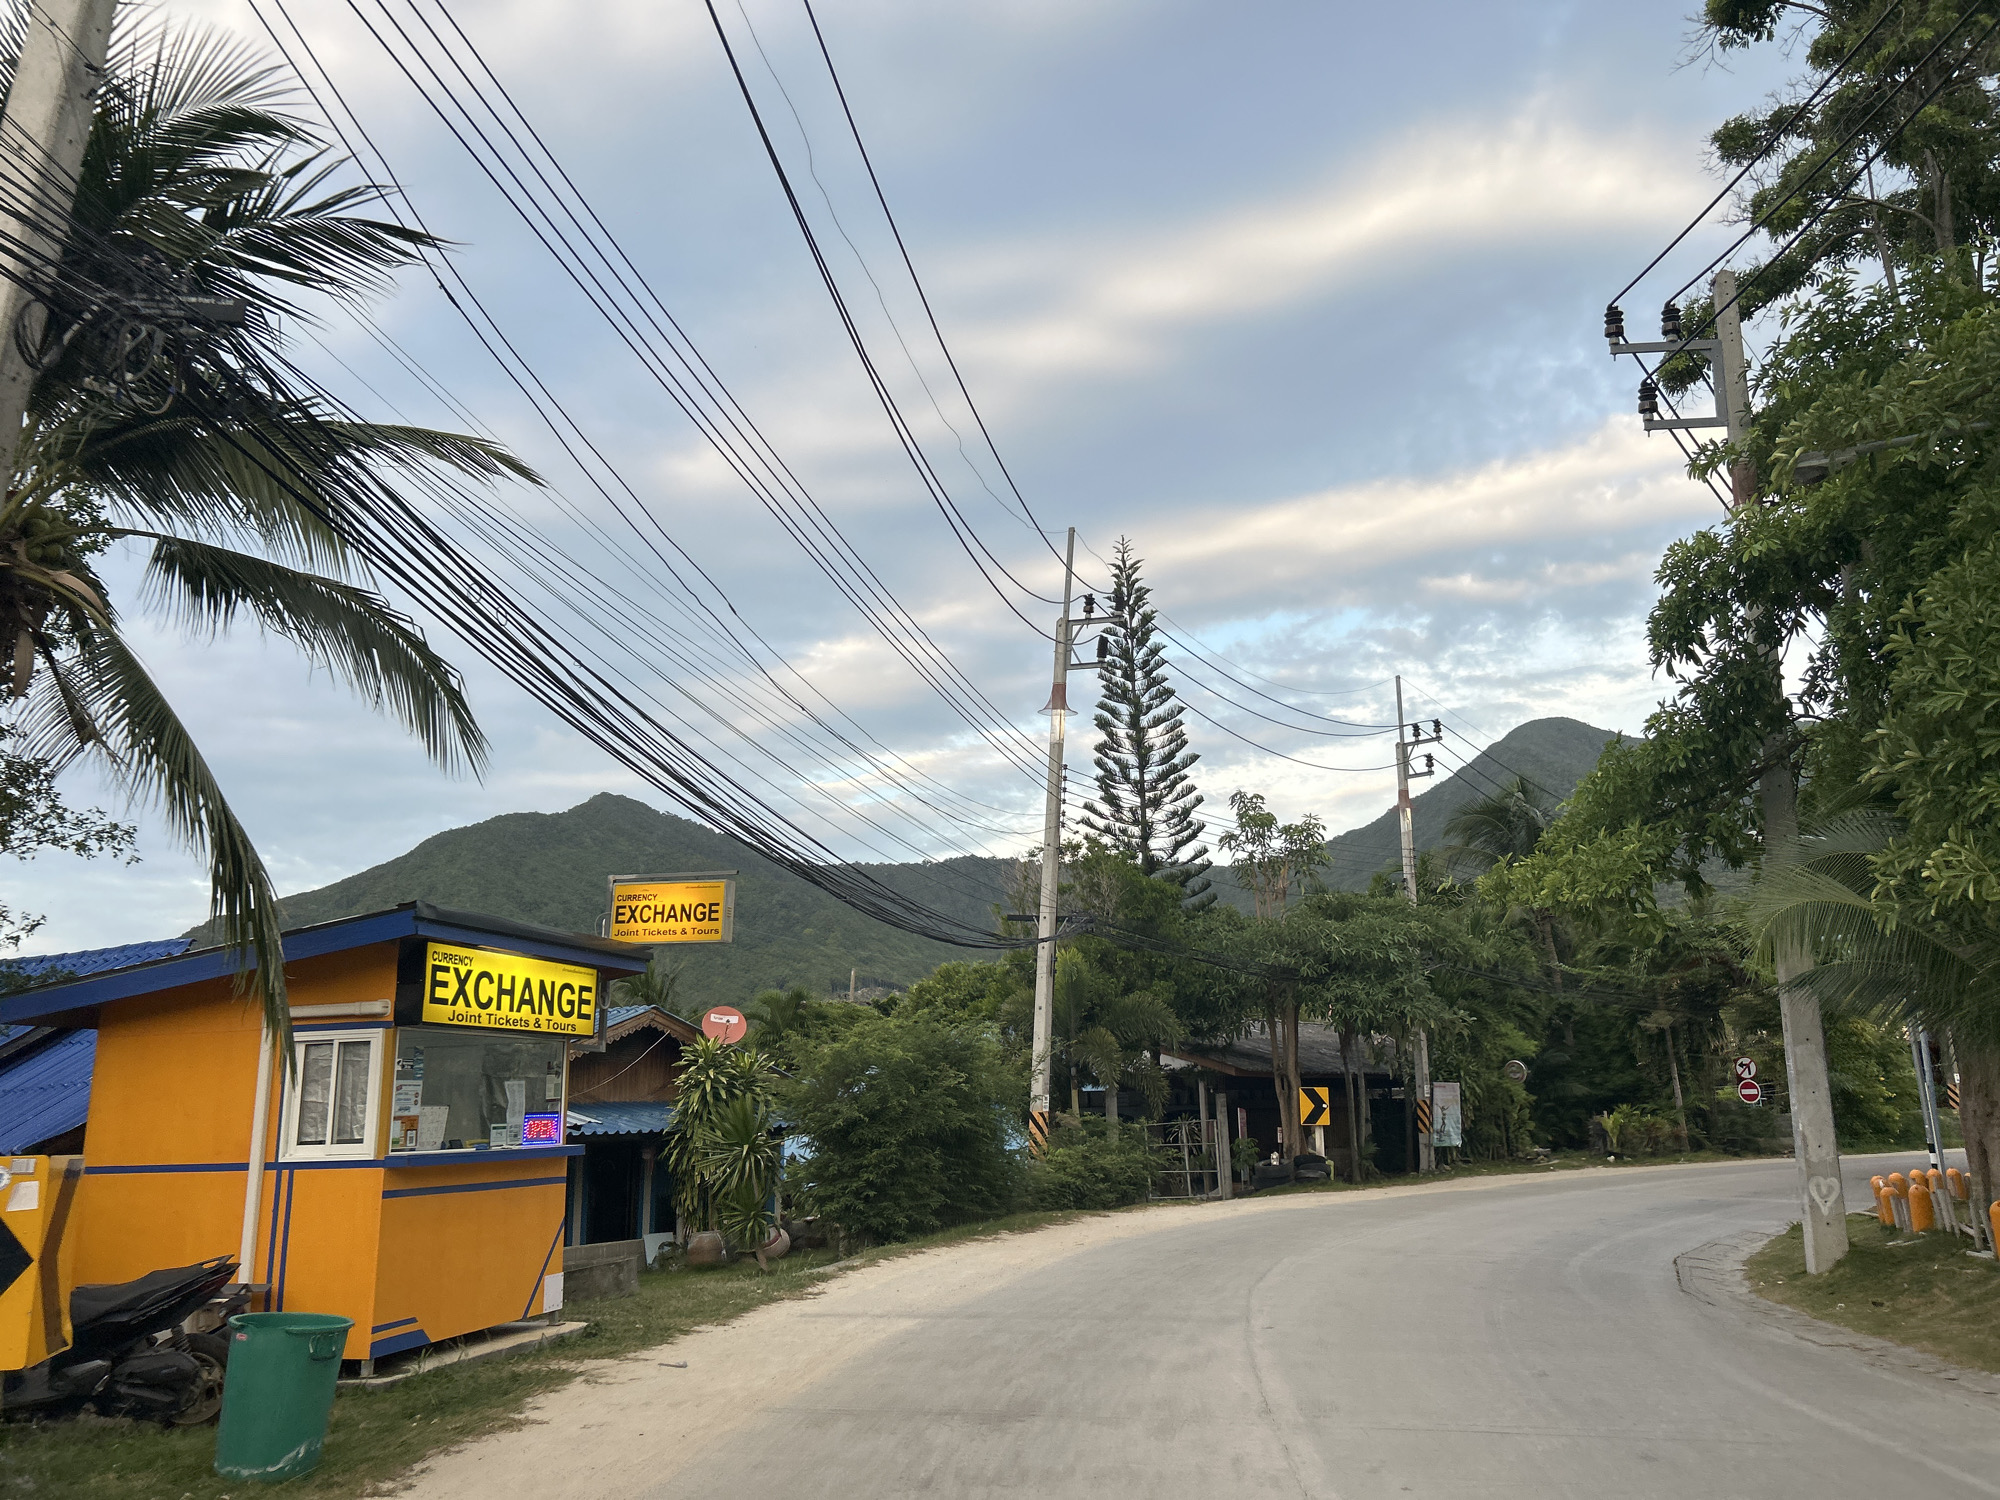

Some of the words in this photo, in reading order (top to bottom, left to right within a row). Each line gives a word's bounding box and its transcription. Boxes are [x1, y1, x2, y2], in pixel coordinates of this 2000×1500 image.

[616, 893, 658, 902] CURRENCY
[614, 902, 720, 925] EXCHANGE
[614, 928, 639, 937] Joint
[642, 928, 677, 936] Tickets
[680, 927, 688, 935] &
[691, 926, 719, 935] Tours
[432, 950, 474, 967] CURRENCY
[429, 963, 593, 1021] EXCHANGE
[448, 1009, 482, 1024] Joint
[485, 1012, 530, 1028] Tickets
[533, 1018, 542, 1029] &
[545, 1018, 577, 1032] Tours
[526, 1120, 557, 1138] OPEN
